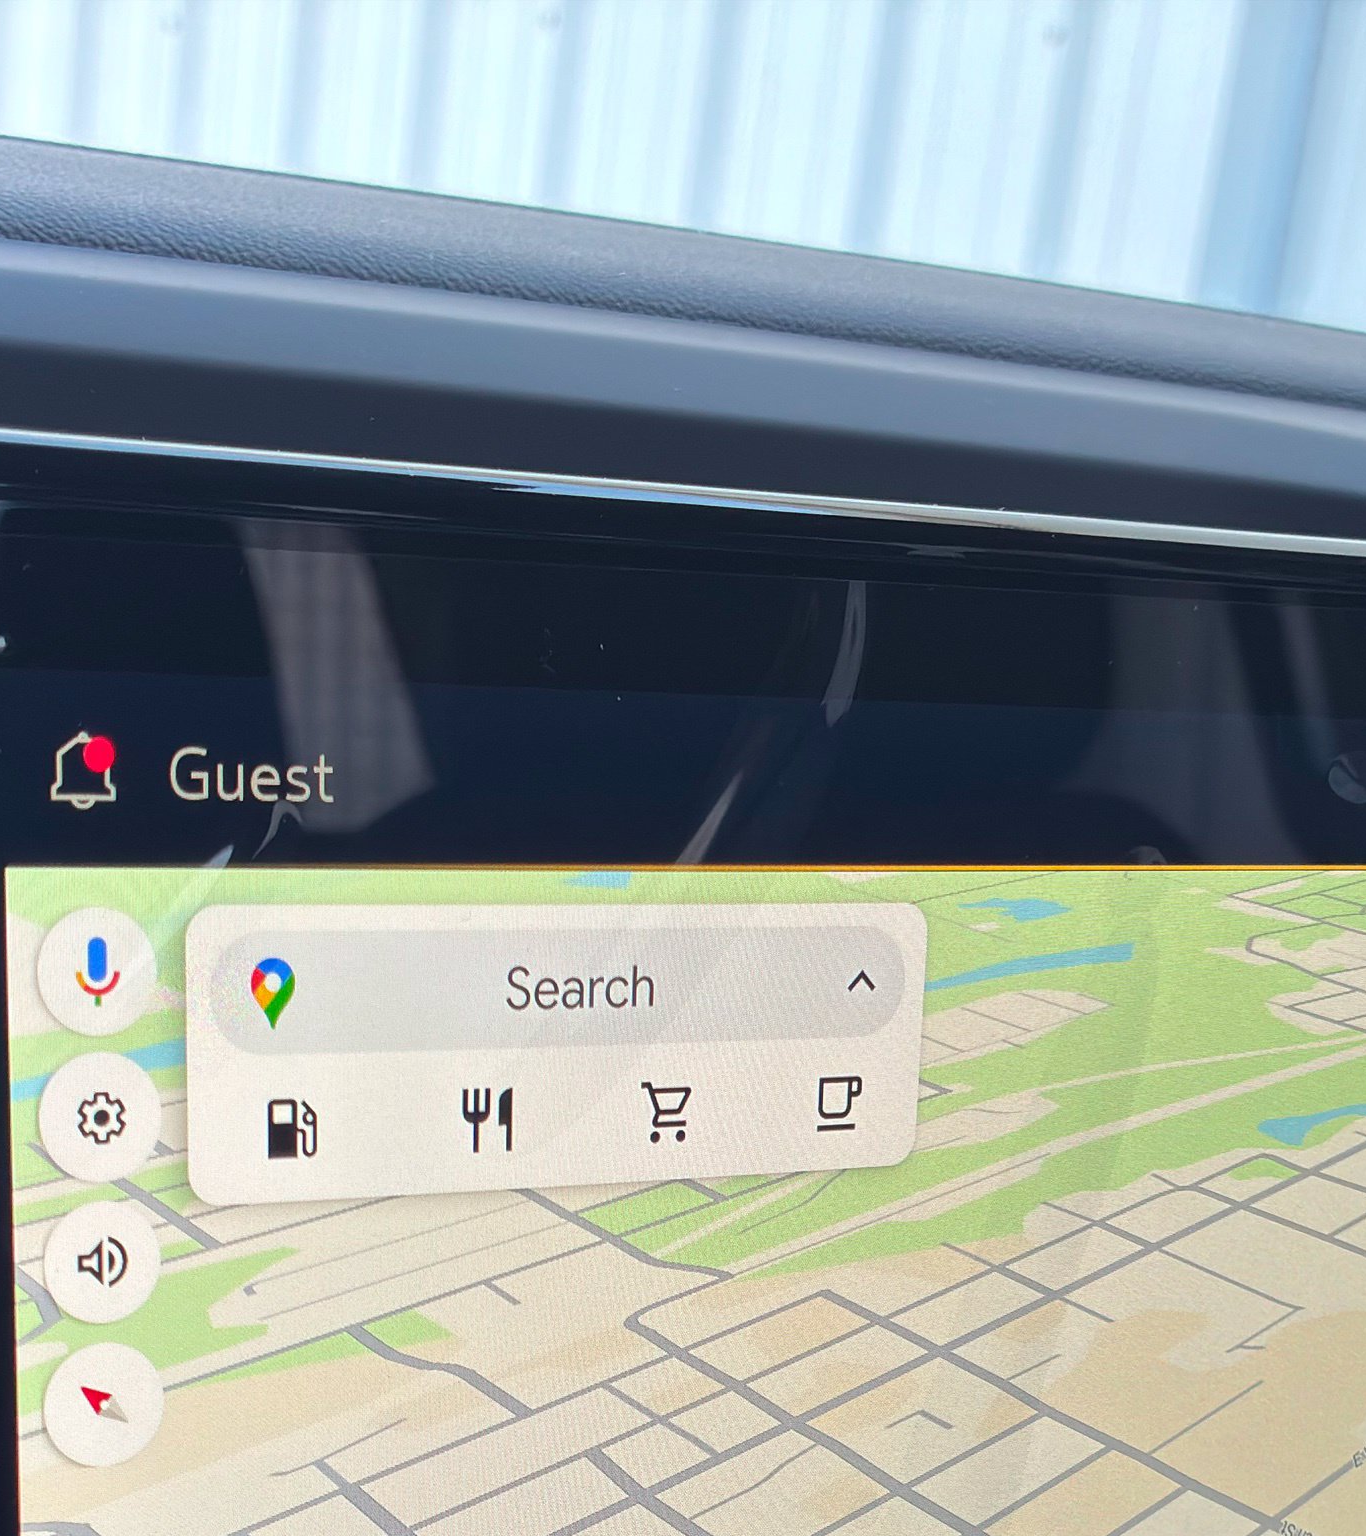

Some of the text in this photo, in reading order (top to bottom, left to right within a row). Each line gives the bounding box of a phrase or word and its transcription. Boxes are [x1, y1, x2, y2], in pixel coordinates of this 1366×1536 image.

[169, 745, 335, 803] Guest
[506, 964, 655, 1011] Search
[1353, 1450, 1363, 1468] E
